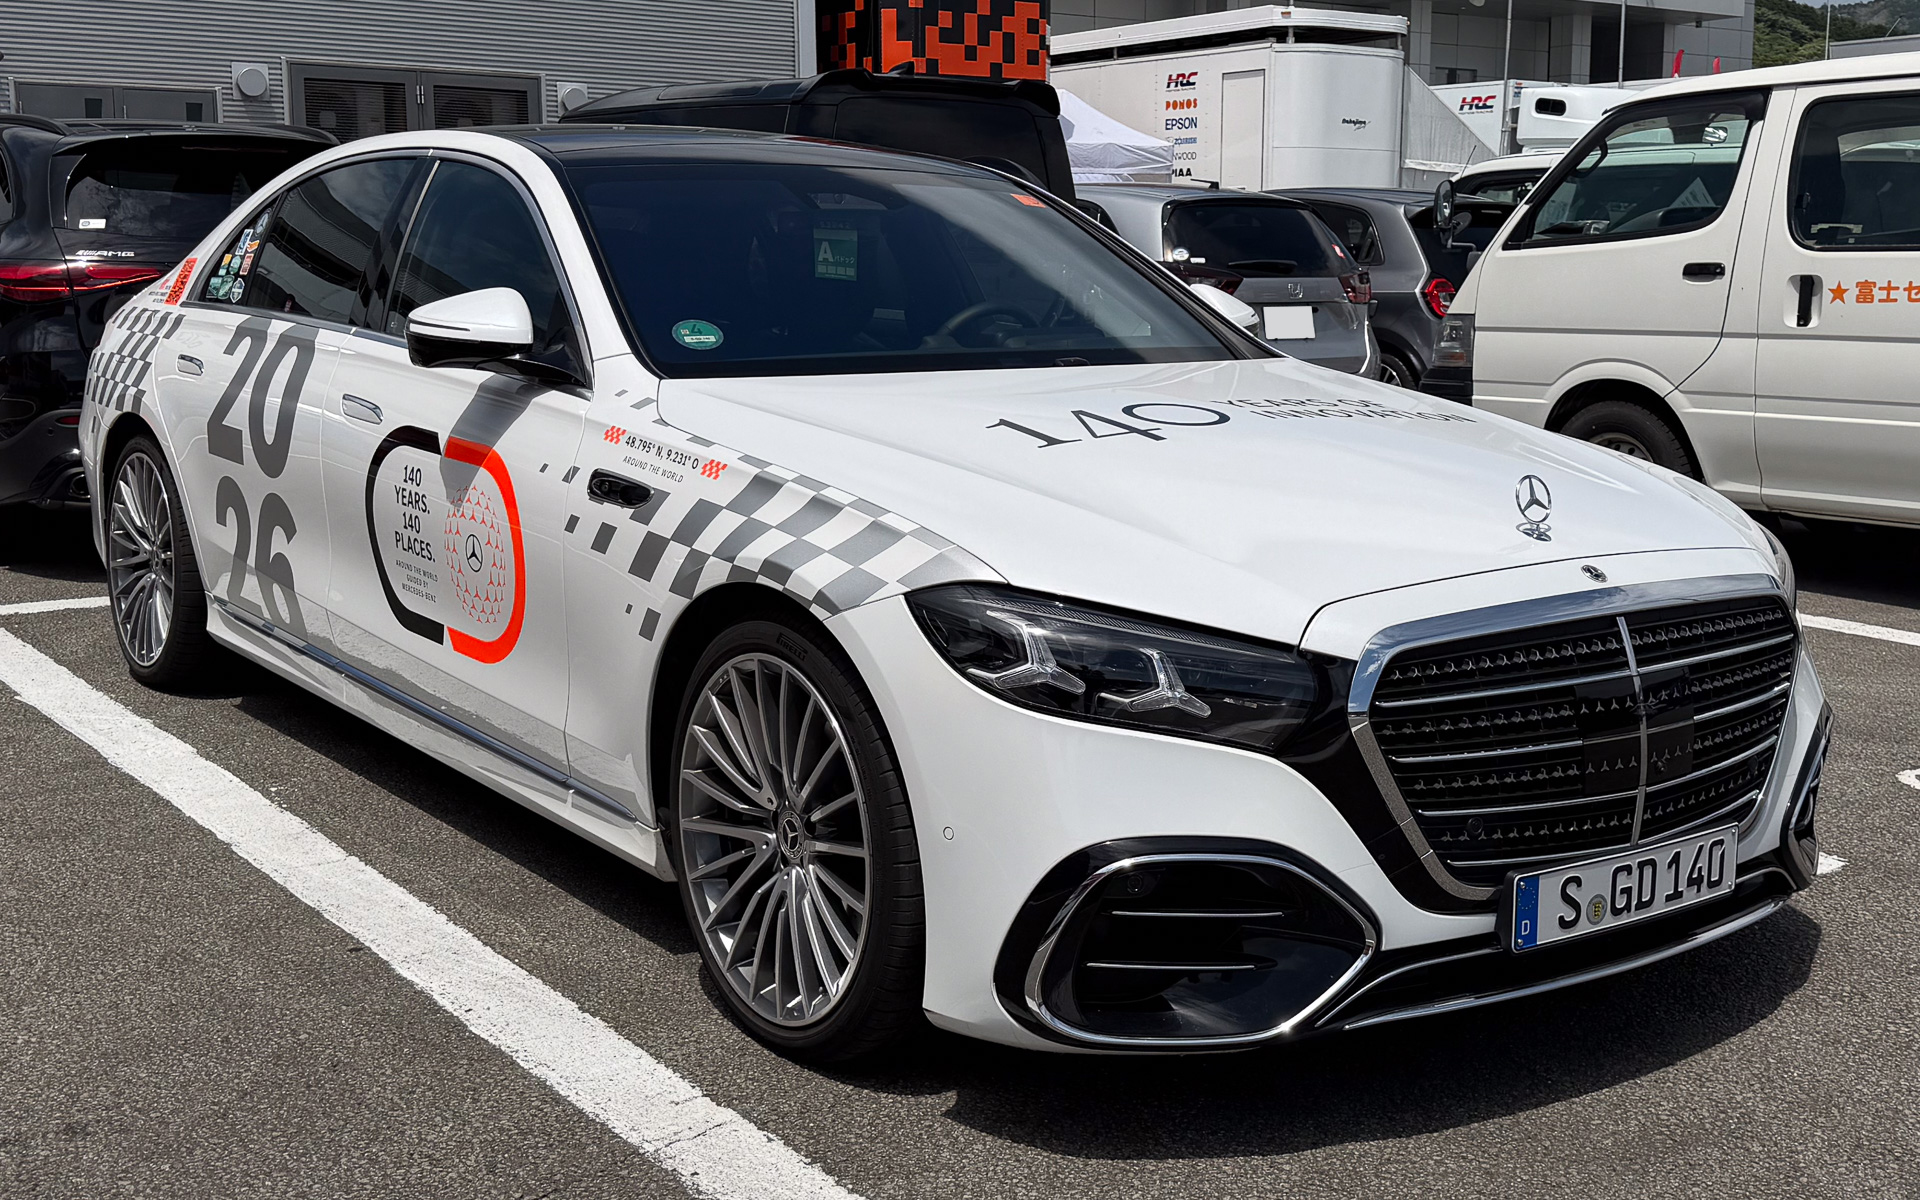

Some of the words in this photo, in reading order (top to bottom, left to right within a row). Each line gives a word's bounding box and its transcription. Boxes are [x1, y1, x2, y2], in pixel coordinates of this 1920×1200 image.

[1166, 71, 1198, 89] HRC
[1165, 98, 1198, 111] PONOS
[1459, 95, 1497, 111] HRC
[1165, 117, 1198, 130] EPSON
[1173, 151, 1197, 161] NWOOD
[817, 240, 834, 262] A
[1855, 279, 1920, 304] 富士セ
[690, 323, 703, 335] 4
[207, 316, 320, 479] 20
[1211, 398, 1338, 409] YEARS
[1336, 398, 1385, 409] OF
[985, 402, 1231, 449] 140
[1251, 409, 1478, 424] INNOVATION
[625, 435, 656, 454] 48.795°
[665, 448, 692, 467] 9.231°
[403, 464, 422, 487] 140
[622, 455, 648, 470] AROUND
[648, 464, 660, 475] THE
[661, 468, 684, 483] WORLD
[394, 485, 431, 515] YEARS.
[402, 511, 421, 534] 140
[215, 475, 309, 640] 26
[394, 530, 436, 563] PLACES.
[395, 559, 413, 572] AROUND
[413, 565, 422, 576] THE
[422, 569, 439, 583] WORLD
[406, 574, 423, 587] GUIDED
[422, 580, 429, 589] BY
[401, 583, 437, 603] MERCEDES-BENZ
[776, 632, 809, 662] PIRELLI
[1557, 874, 1583, 930] S
[1610, 857, 1658, 917] GD
[1664, 838, 1726, 903] 140
[1521, 919, 1530, 935] D
